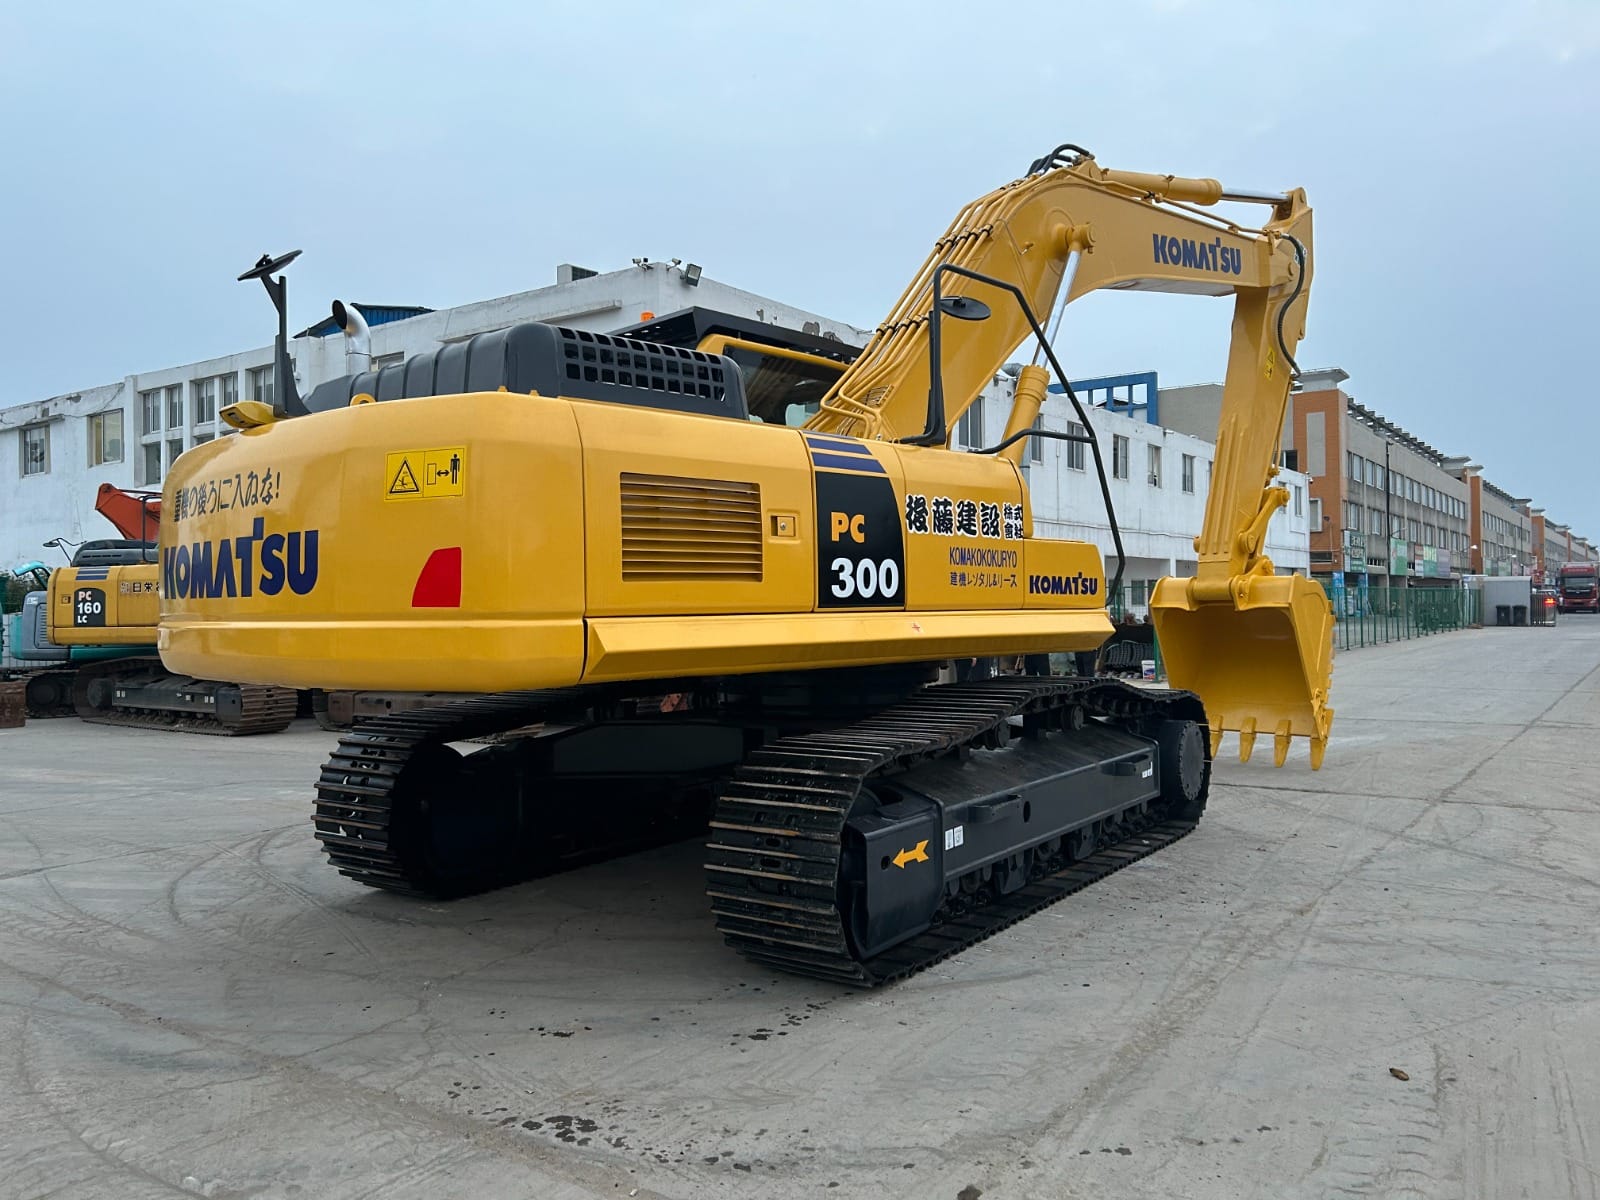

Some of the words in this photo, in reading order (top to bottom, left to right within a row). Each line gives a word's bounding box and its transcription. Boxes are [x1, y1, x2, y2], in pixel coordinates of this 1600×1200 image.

[1152, 233, 1242, 275] KOMATSU
[831, 511, 865, 543] PC
[164, 517, 319, 600] KOMATSU
[831, 557, 899, 598] 300
[1029, 571, 1098, 595] KOMATSU
[77, 601, 102, 614] 160
[78, 591, 92, 601] PC
[77, 615, 88, 623] LC
